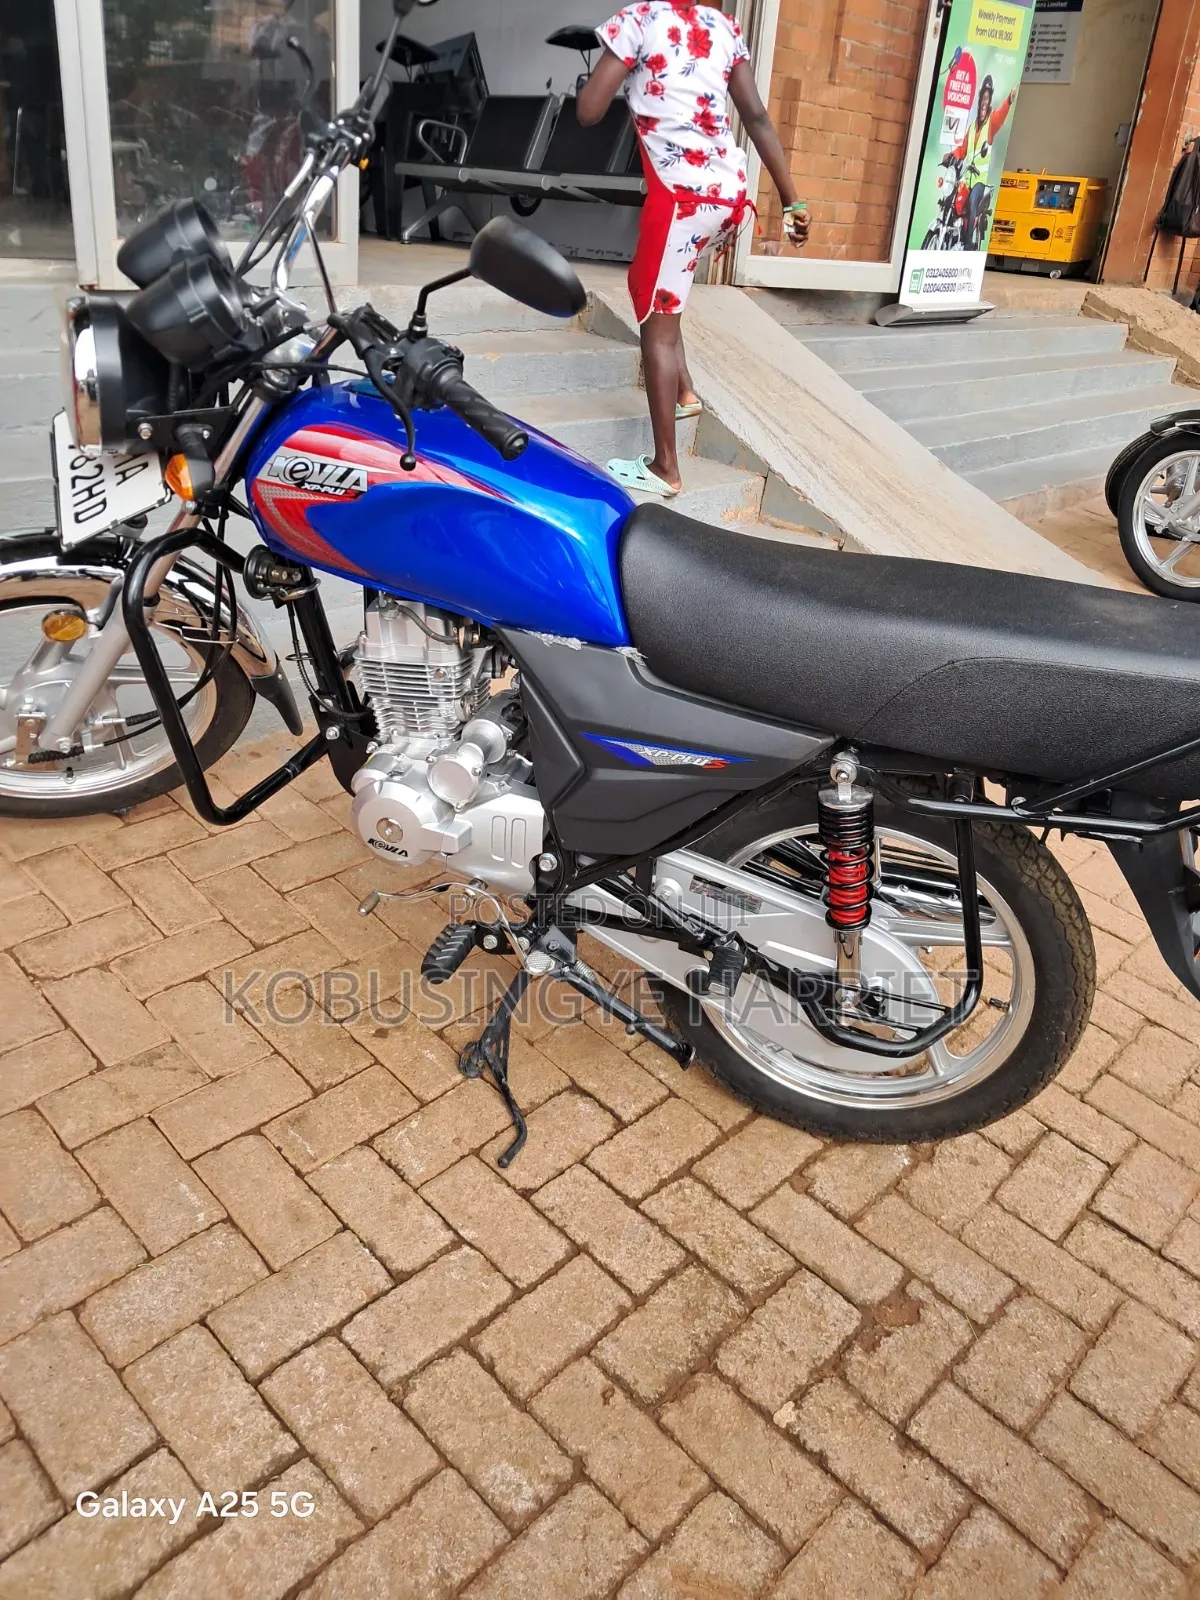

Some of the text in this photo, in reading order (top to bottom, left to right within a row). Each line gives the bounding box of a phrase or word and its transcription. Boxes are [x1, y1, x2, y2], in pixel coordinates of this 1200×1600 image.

[978, 8, 1016, 26] Weekly Payment
[975, 25, 987, 36] from
[988, 28, 998, 39] UGX
[955, 69, 970, 83] GET A
[949, 79, 972, 94] FREE FUEL
[947, 91, 970, 105] VOUCHER
[68, 444, 107, 524] 82HD
[638, 746, 731, 770] XP-PLUS
